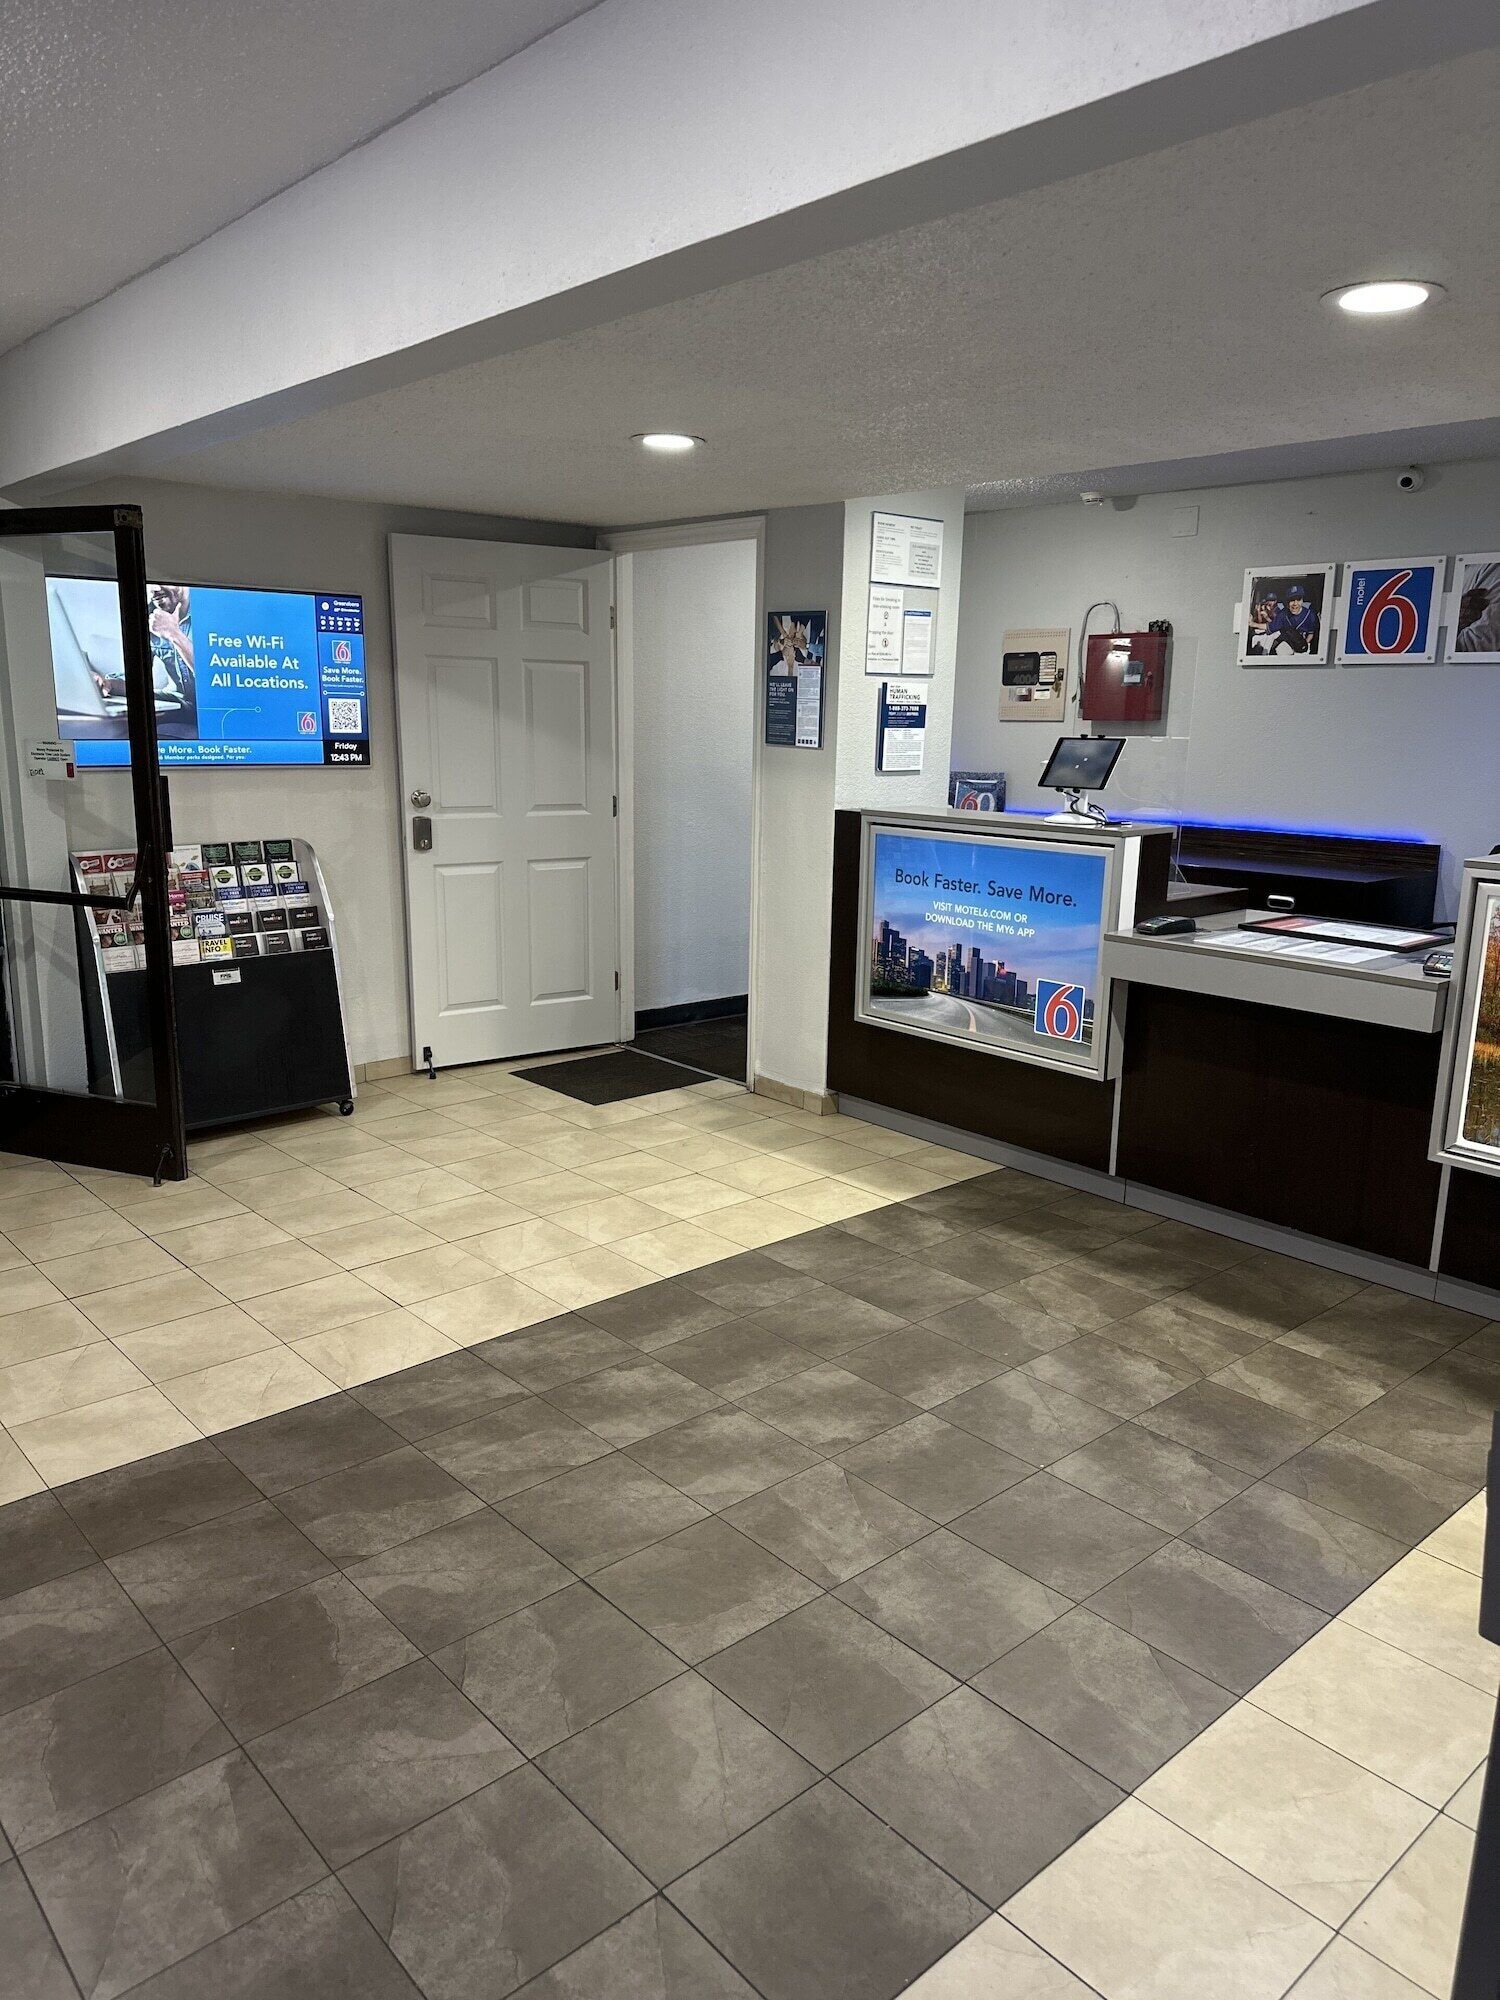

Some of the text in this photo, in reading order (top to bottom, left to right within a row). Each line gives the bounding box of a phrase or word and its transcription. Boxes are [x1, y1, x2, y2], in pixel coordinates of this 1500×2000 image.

[1357, 569, 1419, 655] motel 6
[208, 633, 284, 650] Free Wi-Fi
[336, 640, 350, 660] 6
[210, 653, 299, 670] Available At
[322, 675, 364, 683] Book Faster.
[323, 666, 362, 675] Save More.
[211, 673, 309, 690] All Locations.
[301, 712, 315, 732] 6
[168, 745, 195, 754] More.
[198, 745, 220, 754] Book
[223, 745, 252, 754] Faster.
[334, 742, 357, 751] Friday
[330, 753, 362, 762] 12:43 PM
[895, 868, 1077, 907] Book Faster. Save More.
[195, 913, 224, 924] CRUISE
[932, 900, 1028, 924] VISIT MOTEL6.COM OR
[925, 912, 1035, 938] DOWNLOAD THE MY6 APP
[1044, 984, 1080, 1040] 6
